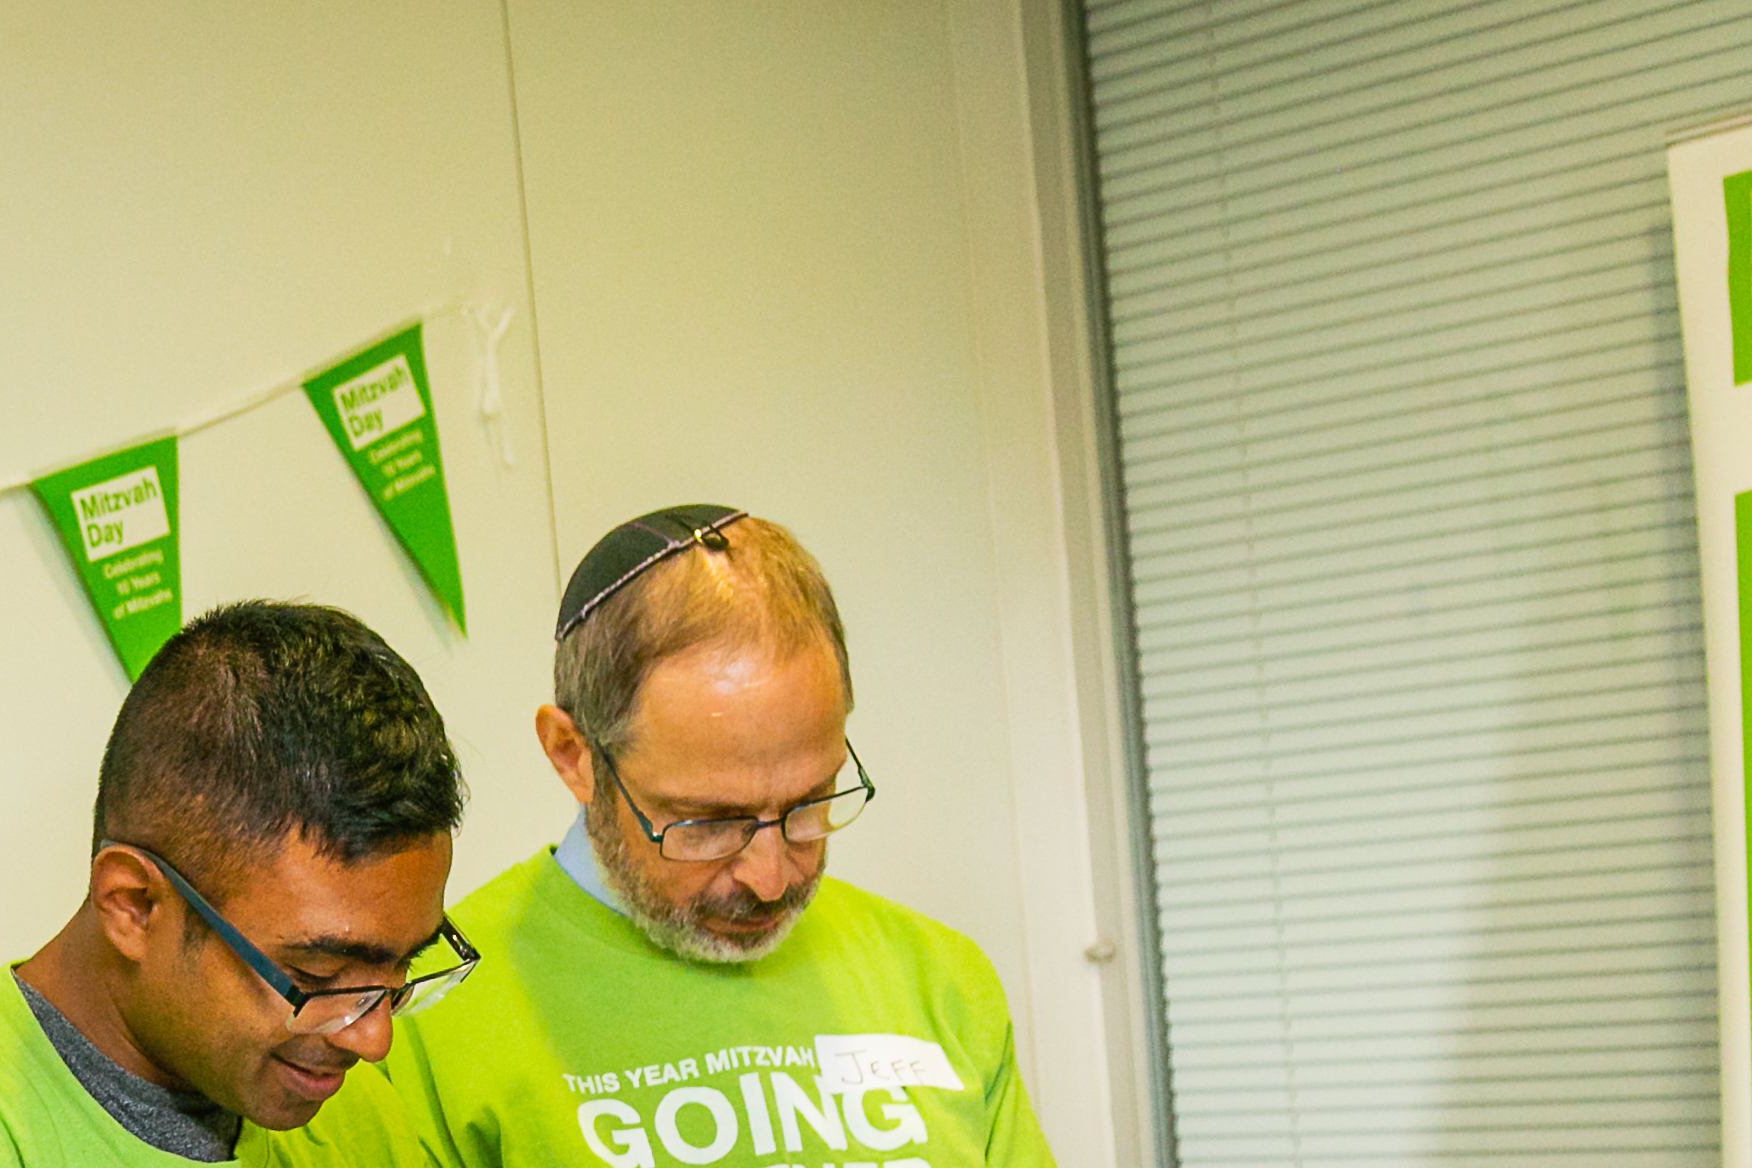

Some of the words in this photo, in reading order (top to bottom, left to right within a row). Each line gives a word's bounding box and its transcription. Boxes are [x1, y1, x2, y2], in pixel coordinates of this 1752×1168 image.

[340, 365, 411, 411] Mitzvah
[348, 409, 383, 438] Day
[79, 476, 158, 521] Mitzvah
[87, 520, 124, 549] Day
[562, 1071, 621, 1094] THIS
[624, 1058, 700, 1089] YEAR
[705, 1045, 816, 1075] MITZVAH
[834, 1049, 927, 1086] JEFF
